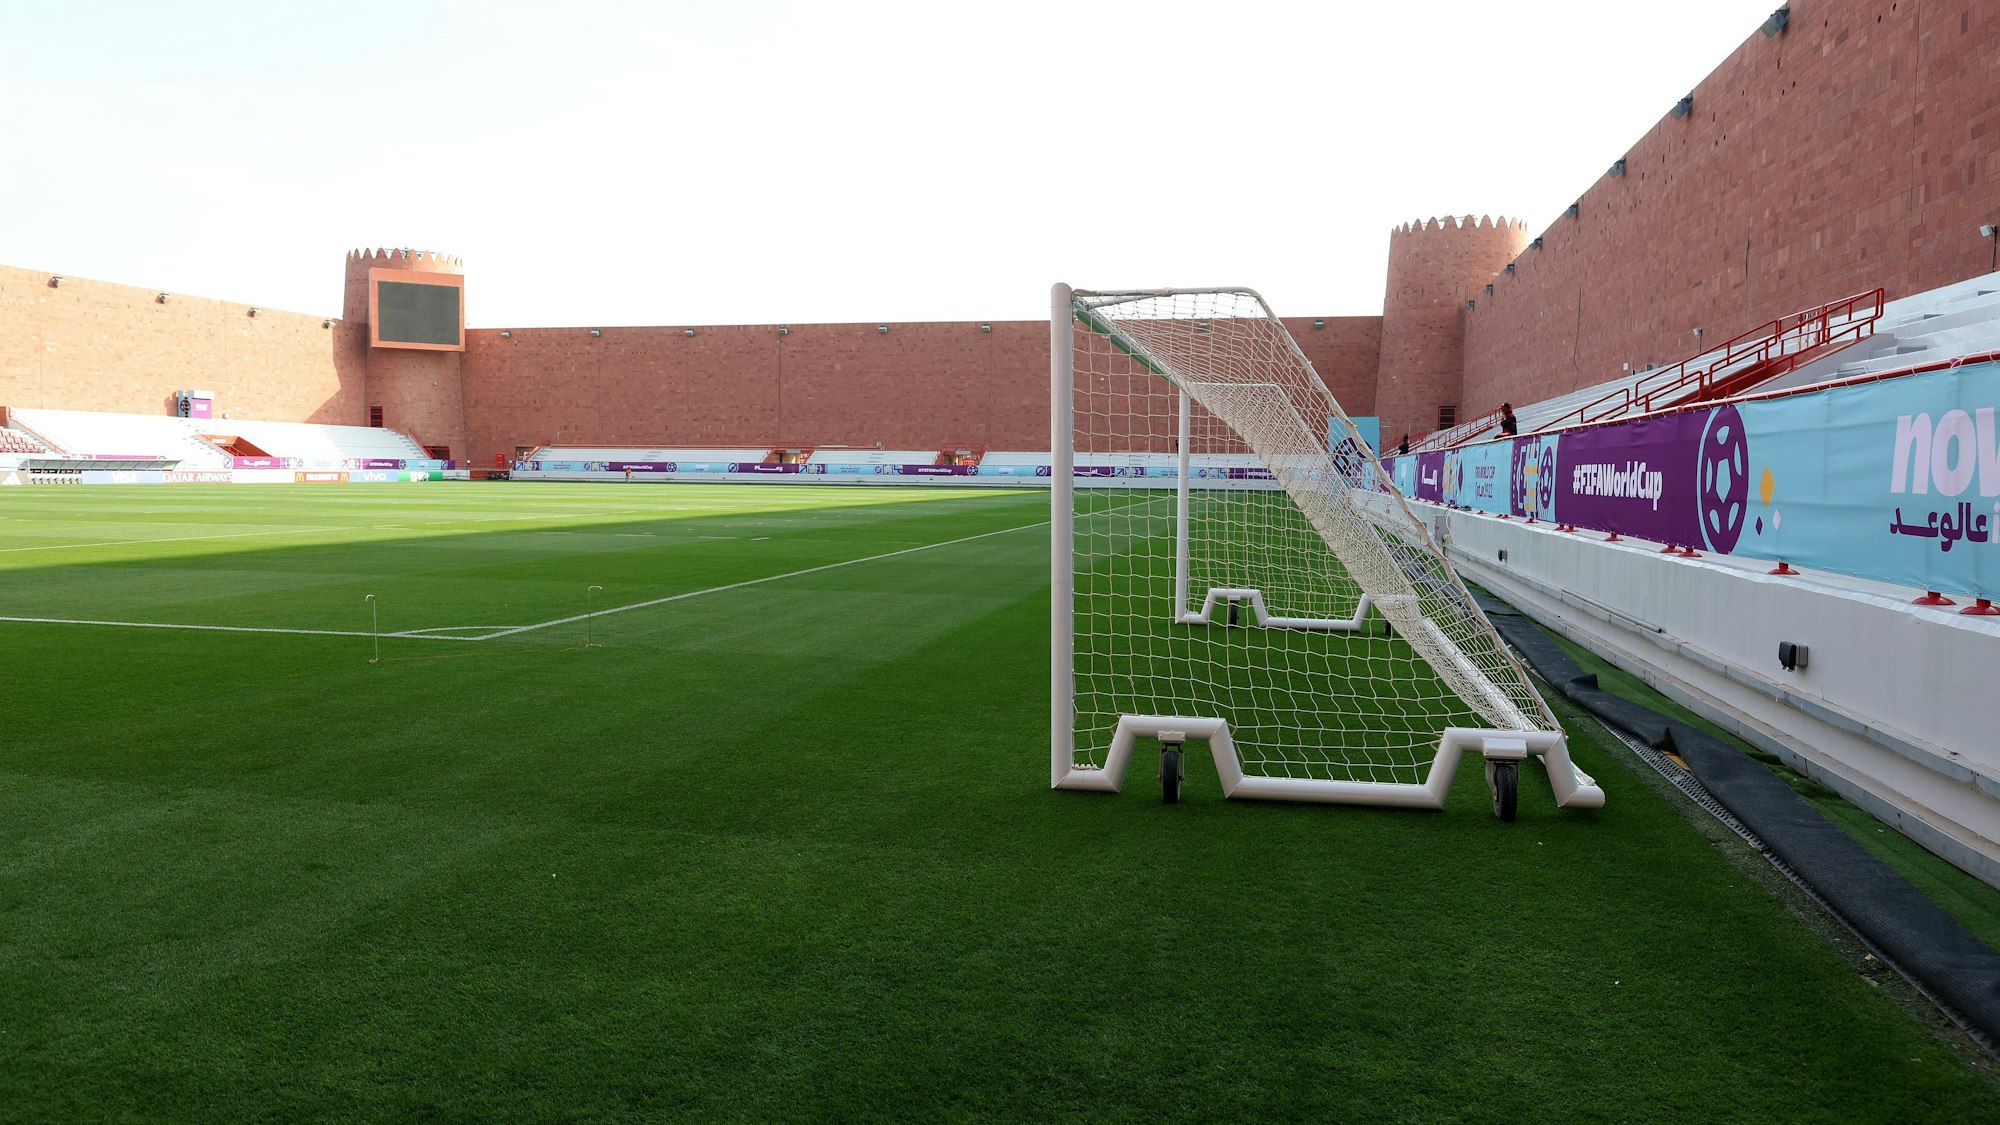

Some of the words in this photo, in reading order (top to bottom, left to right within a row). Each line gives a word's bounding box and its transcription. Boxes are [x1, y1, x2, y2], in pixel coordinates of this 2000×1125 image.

[162, 473, 195, 482] QATAR
[196, 473, 233, 482] AIRWAYS
[1573, 461, 1663, 511] #FIFAWorldCup
